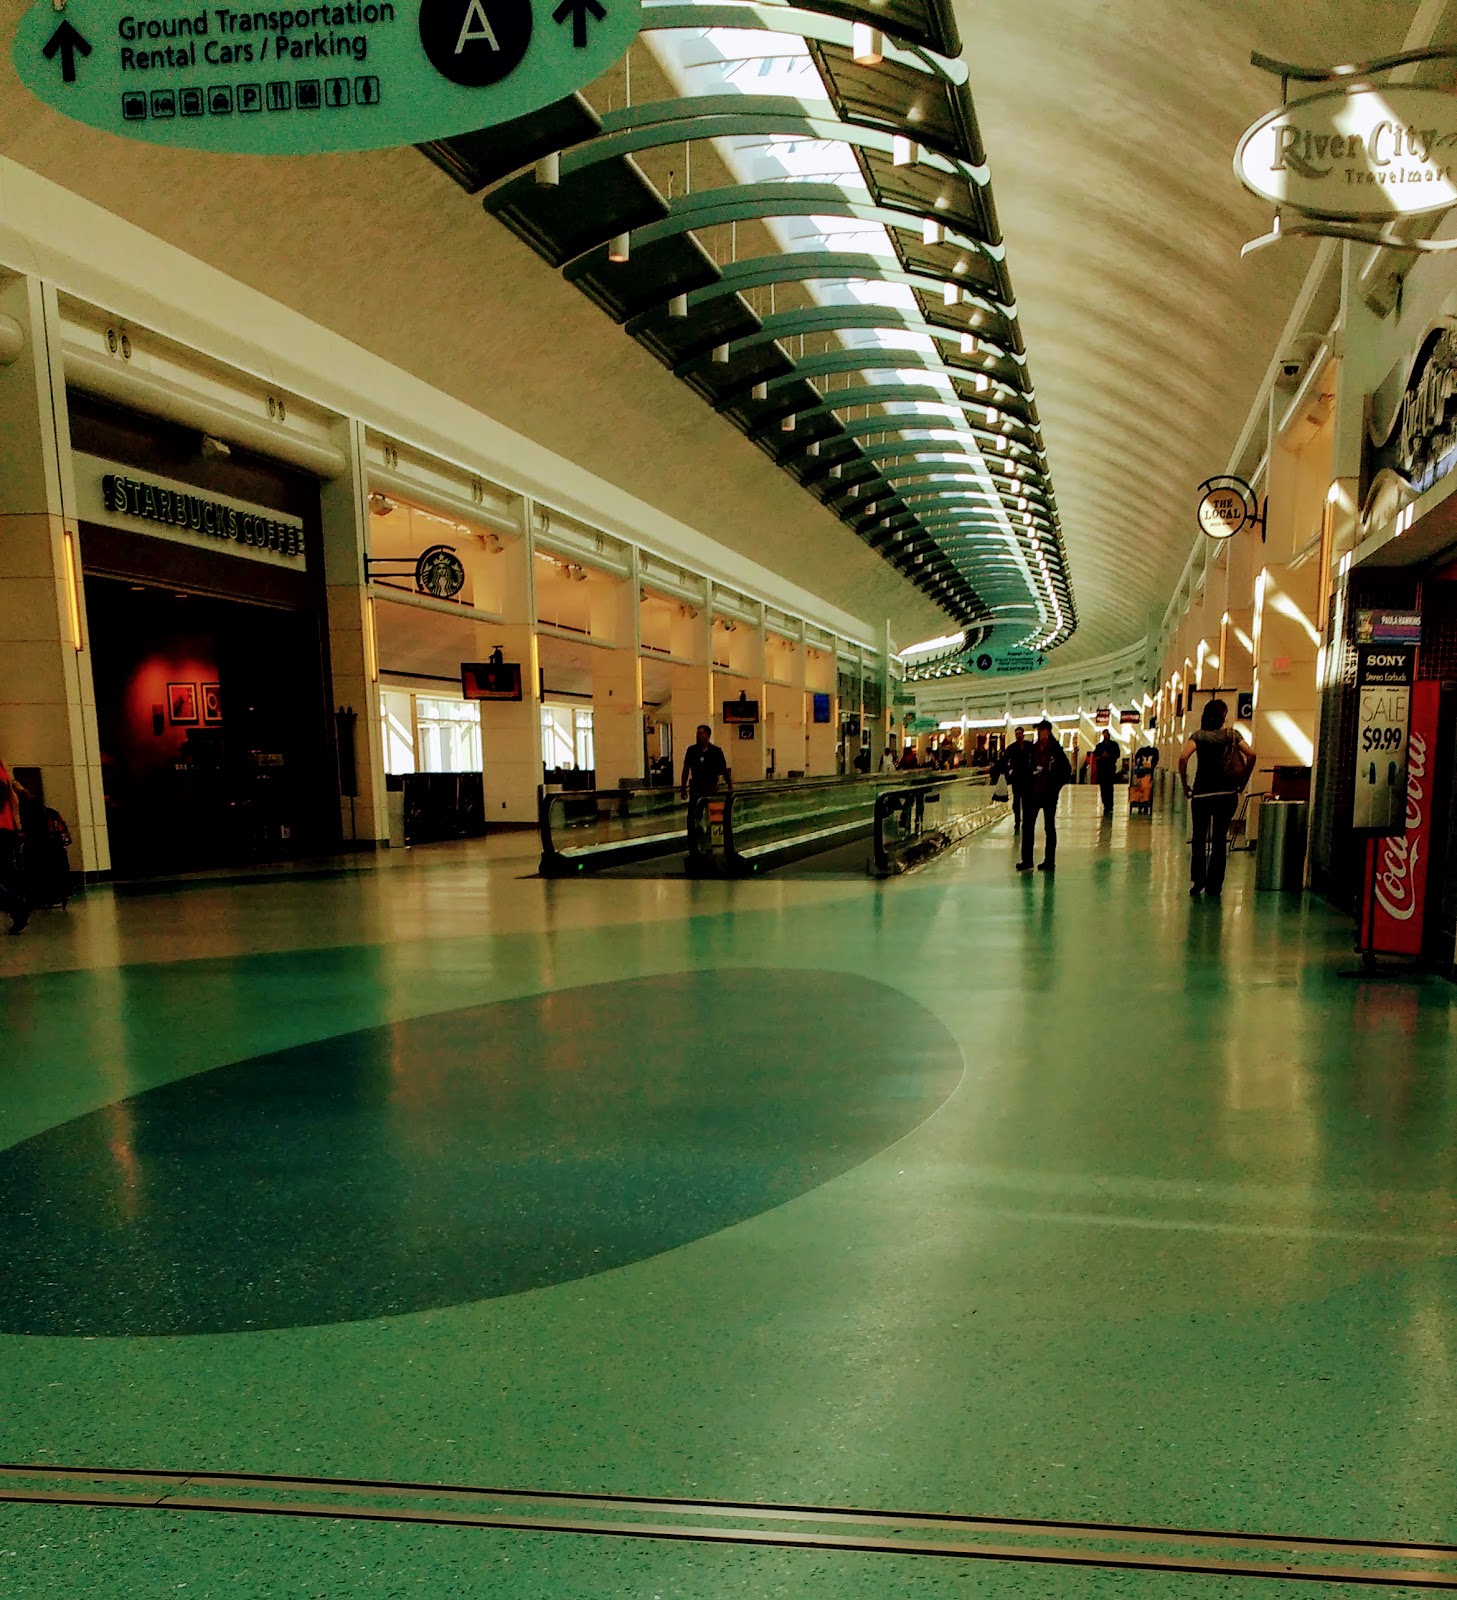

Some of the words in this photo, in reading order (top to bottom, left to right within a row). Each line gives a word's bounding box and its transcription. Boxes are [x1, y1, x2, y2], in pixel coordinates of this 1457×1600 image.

[118, 9, 208, 40] Ground
[214, 0, 395, 35] Transportation
[454, 0, 500, 54] A
[121, 40, 196, 71] Rental
[204, 40, 254, 64] Cars
[260, 36, 268, 60] /
[275, 31, 368, 61] Parking
[1270, 123, 1363, 179] River
[1368, 120, 1438, 166] City
[108, 474, 239, 540] STARBUCKS
[242, 511, 305, 556] COFFEE
[1205, 508, 1241, 520] LOCAL
[1212, 499, 1233, 508] THE
[1366, 654, 1406, 667] SONY
[1365, 672, 1384, 682] Stereo
[1384, 672, 1407, 682] Earbuds
[1361, 696, 1406, 722] SALE
[1362, 725, 1402, 752] $9.99
